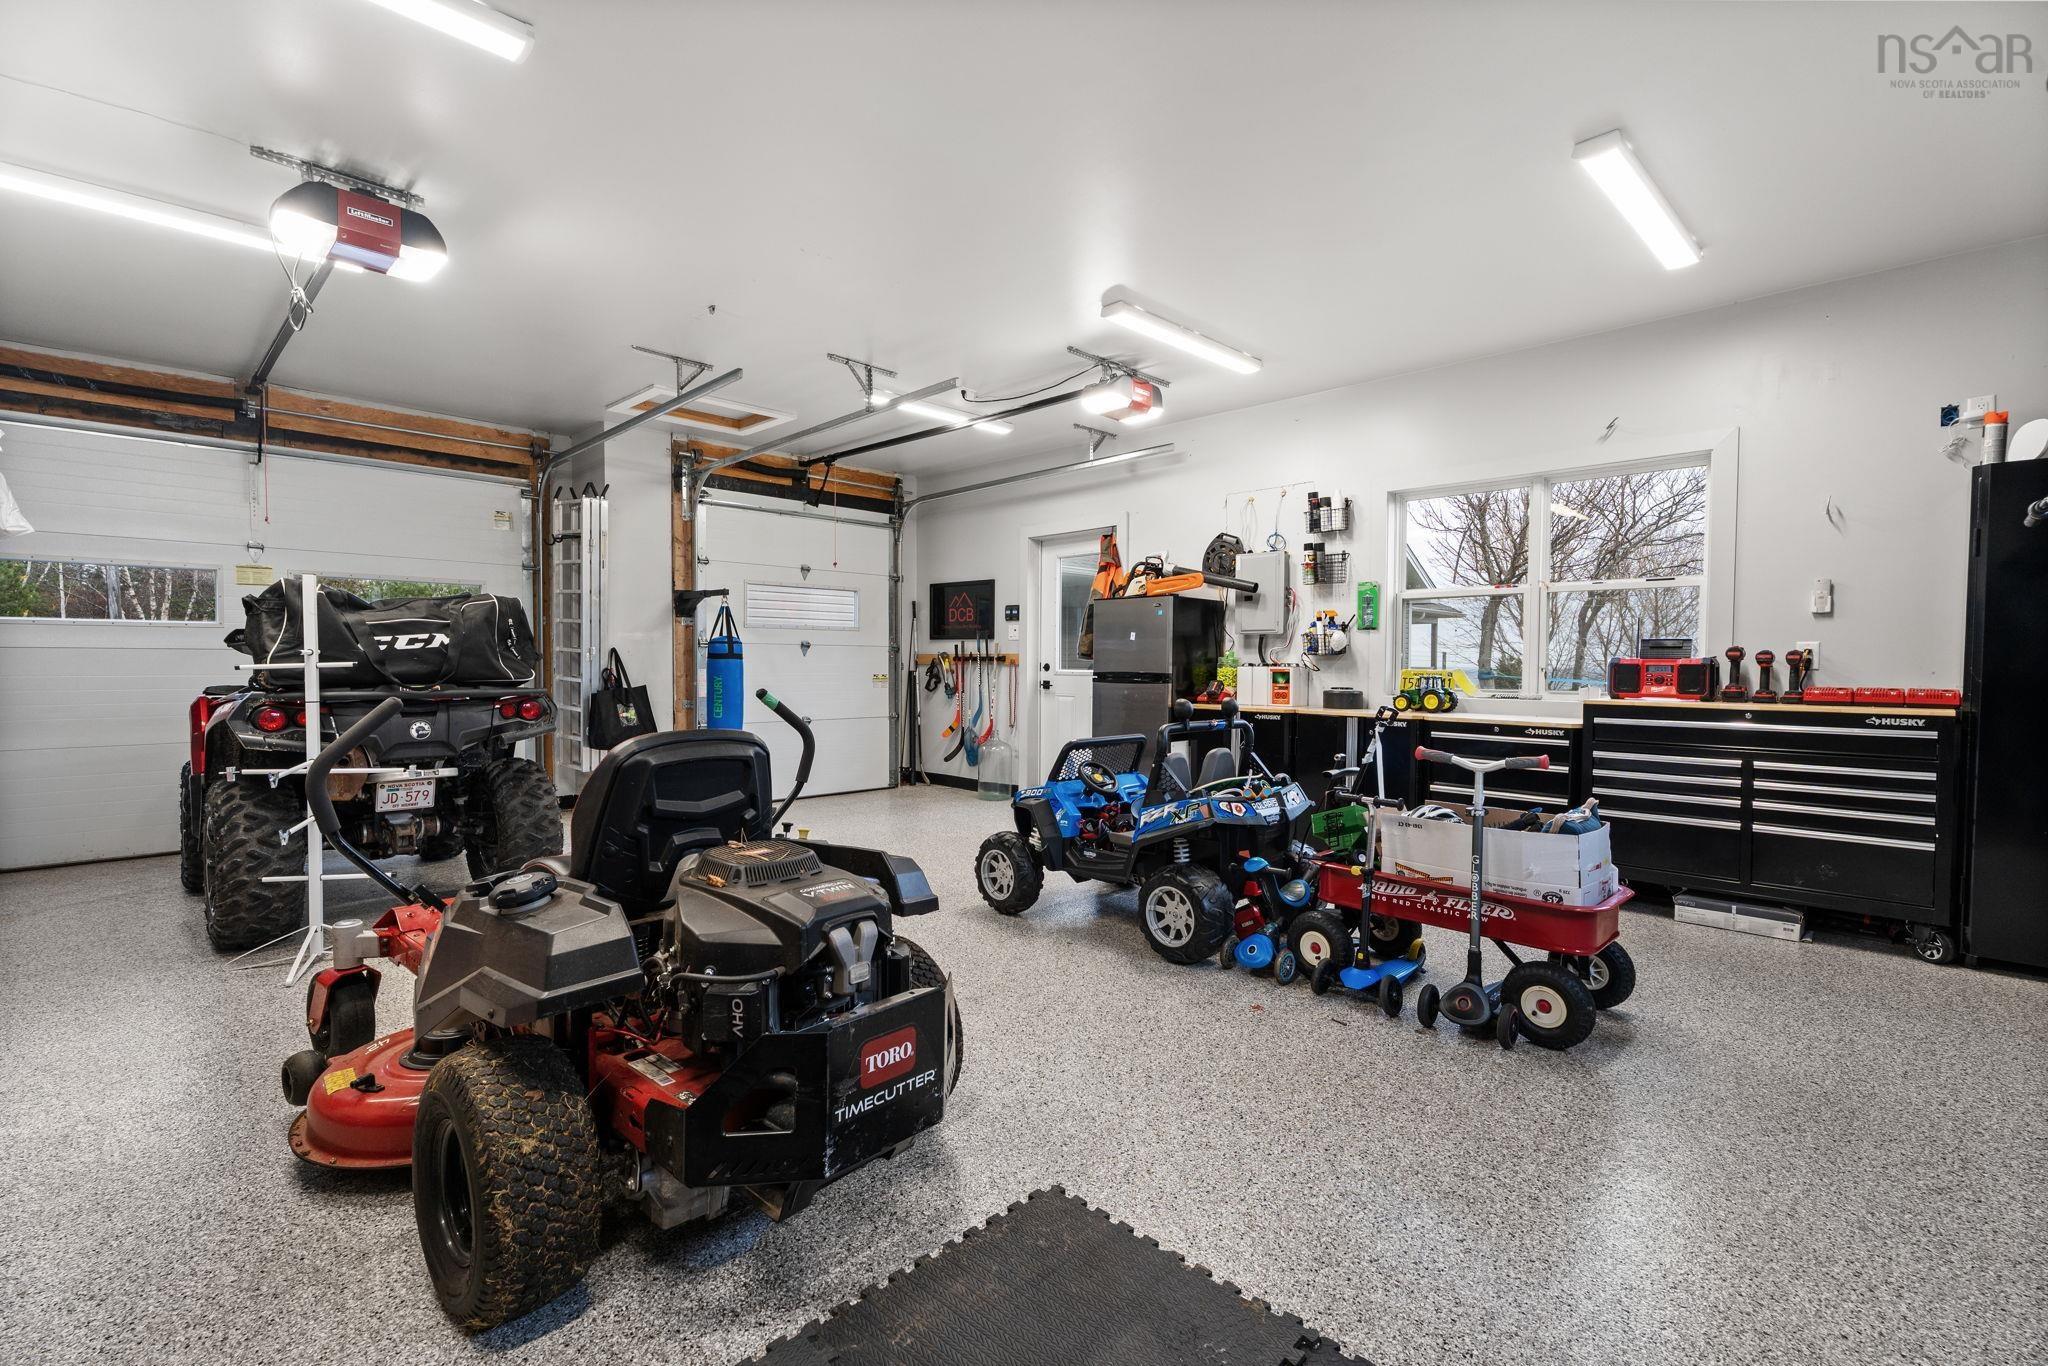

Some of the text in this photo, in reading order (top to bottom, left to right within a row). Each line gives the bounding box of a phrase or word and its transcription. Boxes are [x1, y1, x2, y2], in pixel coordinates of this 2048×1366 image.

[949, 607, 974, 622] DCB
[713, 675, 723, 718] CENTURY
[1261, 713, 1281, 721] HUSKY
[1881, 717, 1926, 727] HUSKY
[1535, 728, 1565, 736] HUSKY
[1471, 855, 1480, 921] GLOBBER
[1392, 898, 1411, 907] RED
[1416, 903, 1460, 917] CLASSIC
[731, 998, 744, 1038] OHV
[865, 1041, 913, 1073] TORO
[834, 1068, 936, 1123] TIMECUTTER
